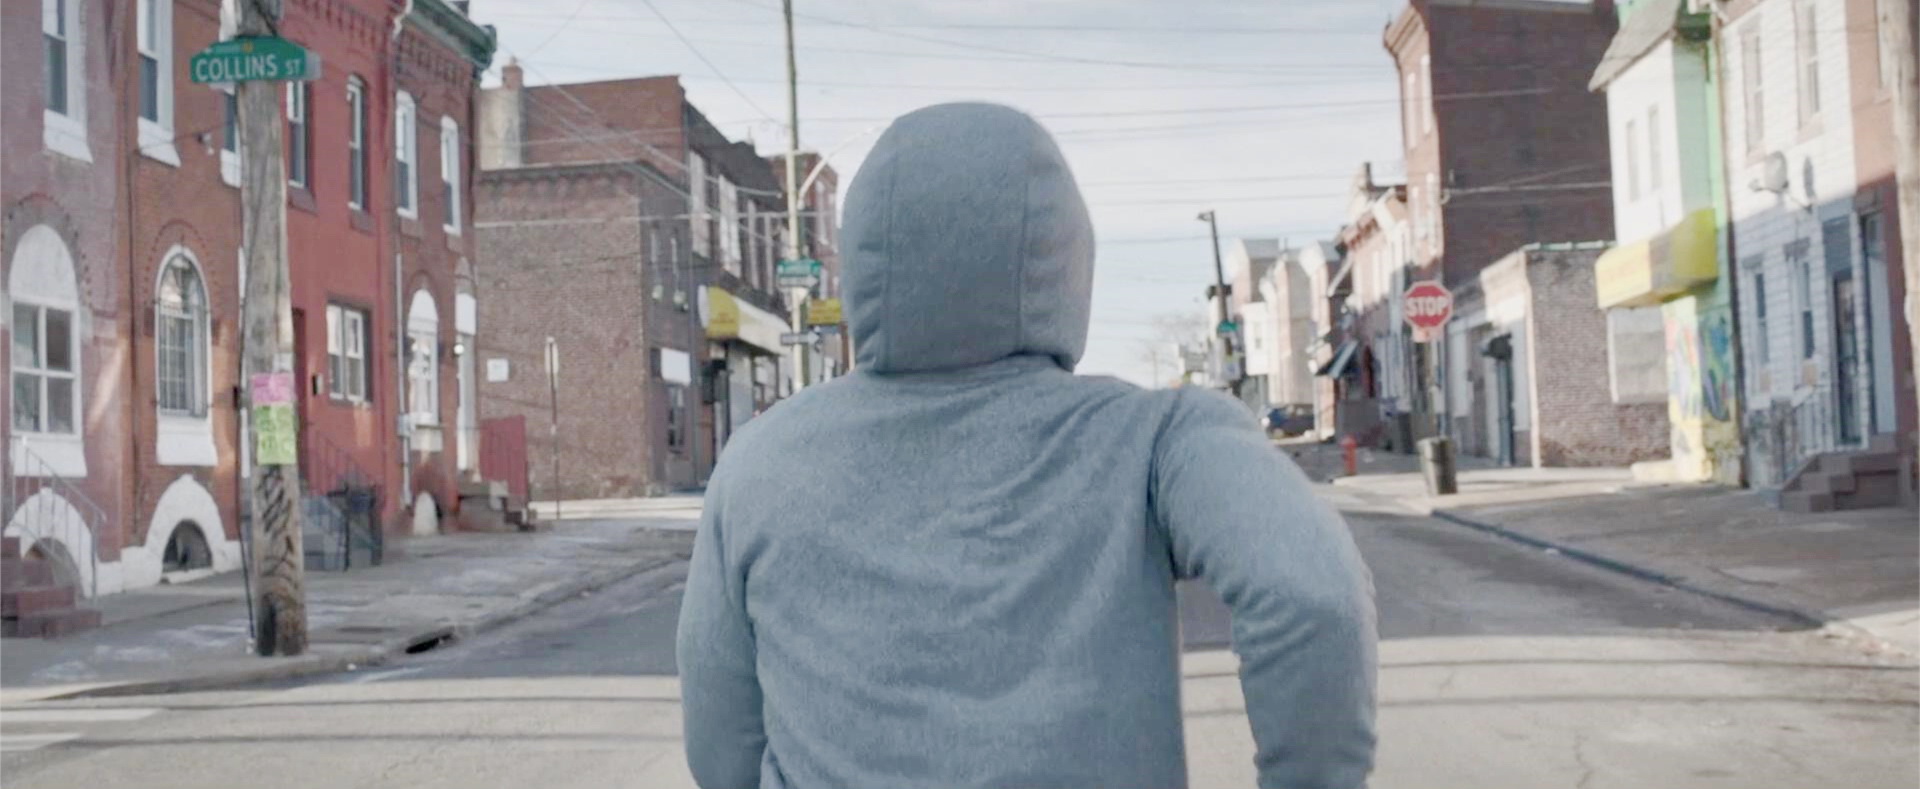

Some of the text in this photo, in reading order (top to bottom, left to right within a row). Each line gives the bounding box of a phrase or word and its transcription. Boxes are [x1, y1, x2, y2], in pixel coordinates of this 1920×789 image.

[195, 54, 301, 80] COLLINS ST
[1406, 296, 1450, 316] STOP
